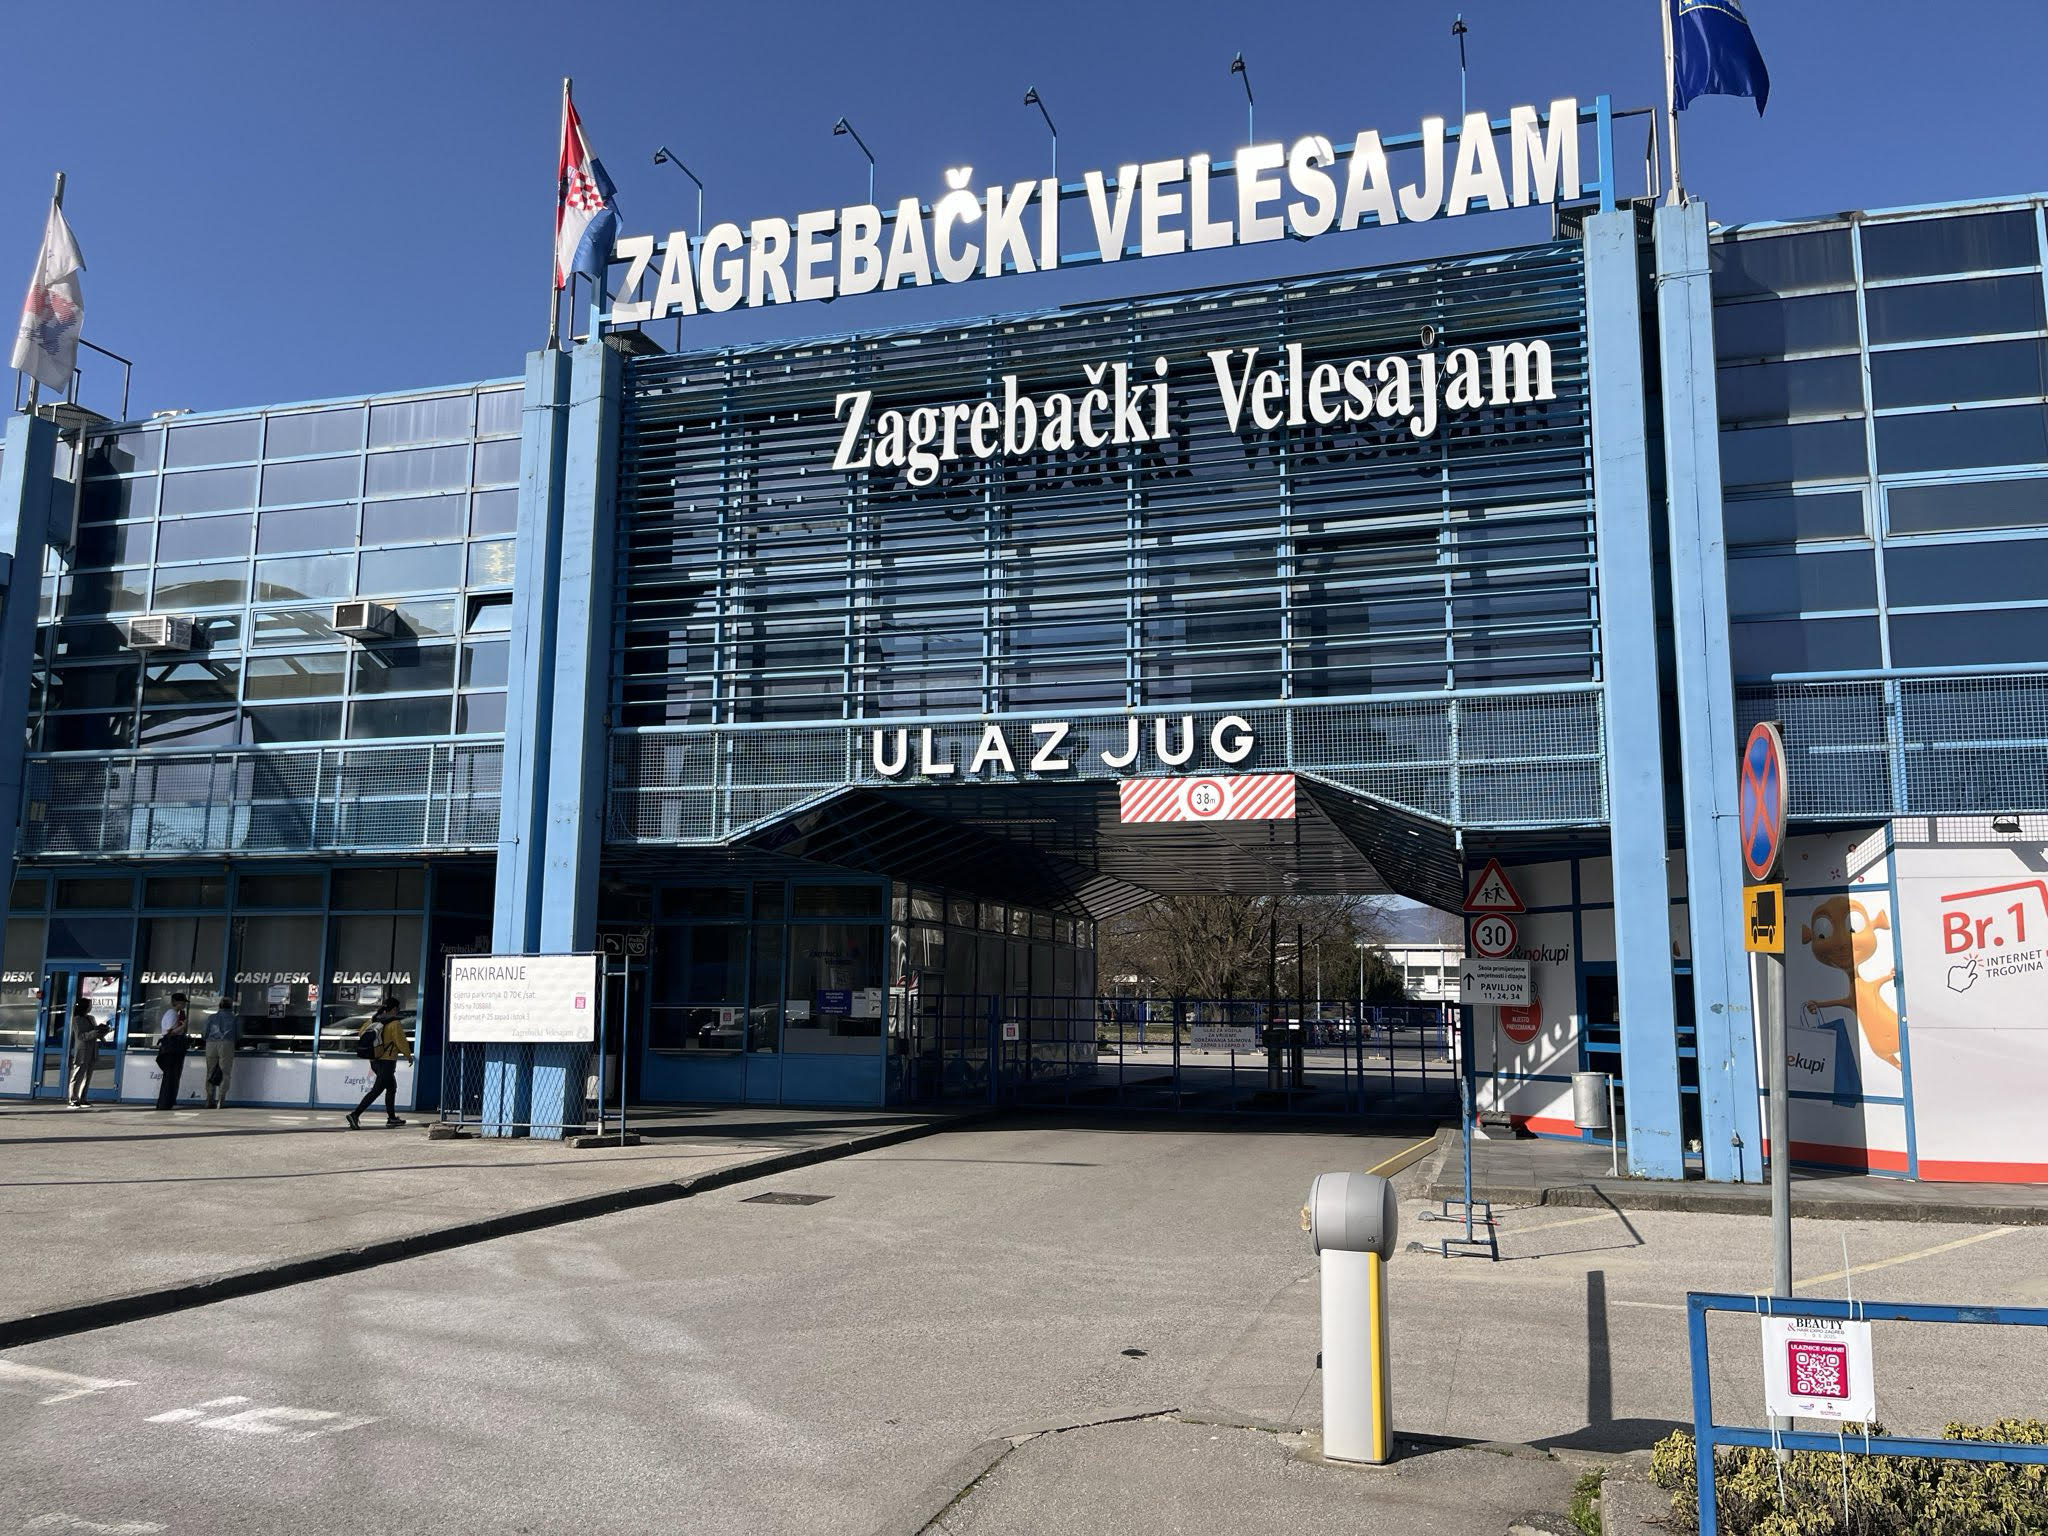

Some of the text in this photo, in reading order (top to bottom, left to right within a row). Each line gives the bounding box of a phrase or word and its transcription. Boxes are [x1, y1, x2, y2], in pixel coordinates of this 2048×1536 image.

[611, 98, 1581, 325] ZAGREBAČKI VELESAJAM
[832, 325, 1557, 487] Zagrebački Velesajam
[873, 715, 1255, 776] ULAZ JUG
[1942, 902, 2027, 954] Br.1
[1482, 926, 1506, 946] 30
[1985, 950, 2043, 967] INTERNET
[2, 971, 35, 983] DESK
[455, 966, 527, 981] PARKIRANJE
[1985, 961, 2044, 978] TRGOVINA
[140, 971, 214, 984] BLAGAJNA
[234, 971, 312, 984] CASH DESK
[332, 971, 411, 984] BLAGAJNA
[1480, 983, 1523, 992] PAVILJON
[92, 998, 114, 1006] EAUTY
[1787, 1053, 1826, 1075] ekupi
[1796, 1318, 1844, 1330] BEAUTY
[1790, 1344, 1820, 1352] ULAZNICE
